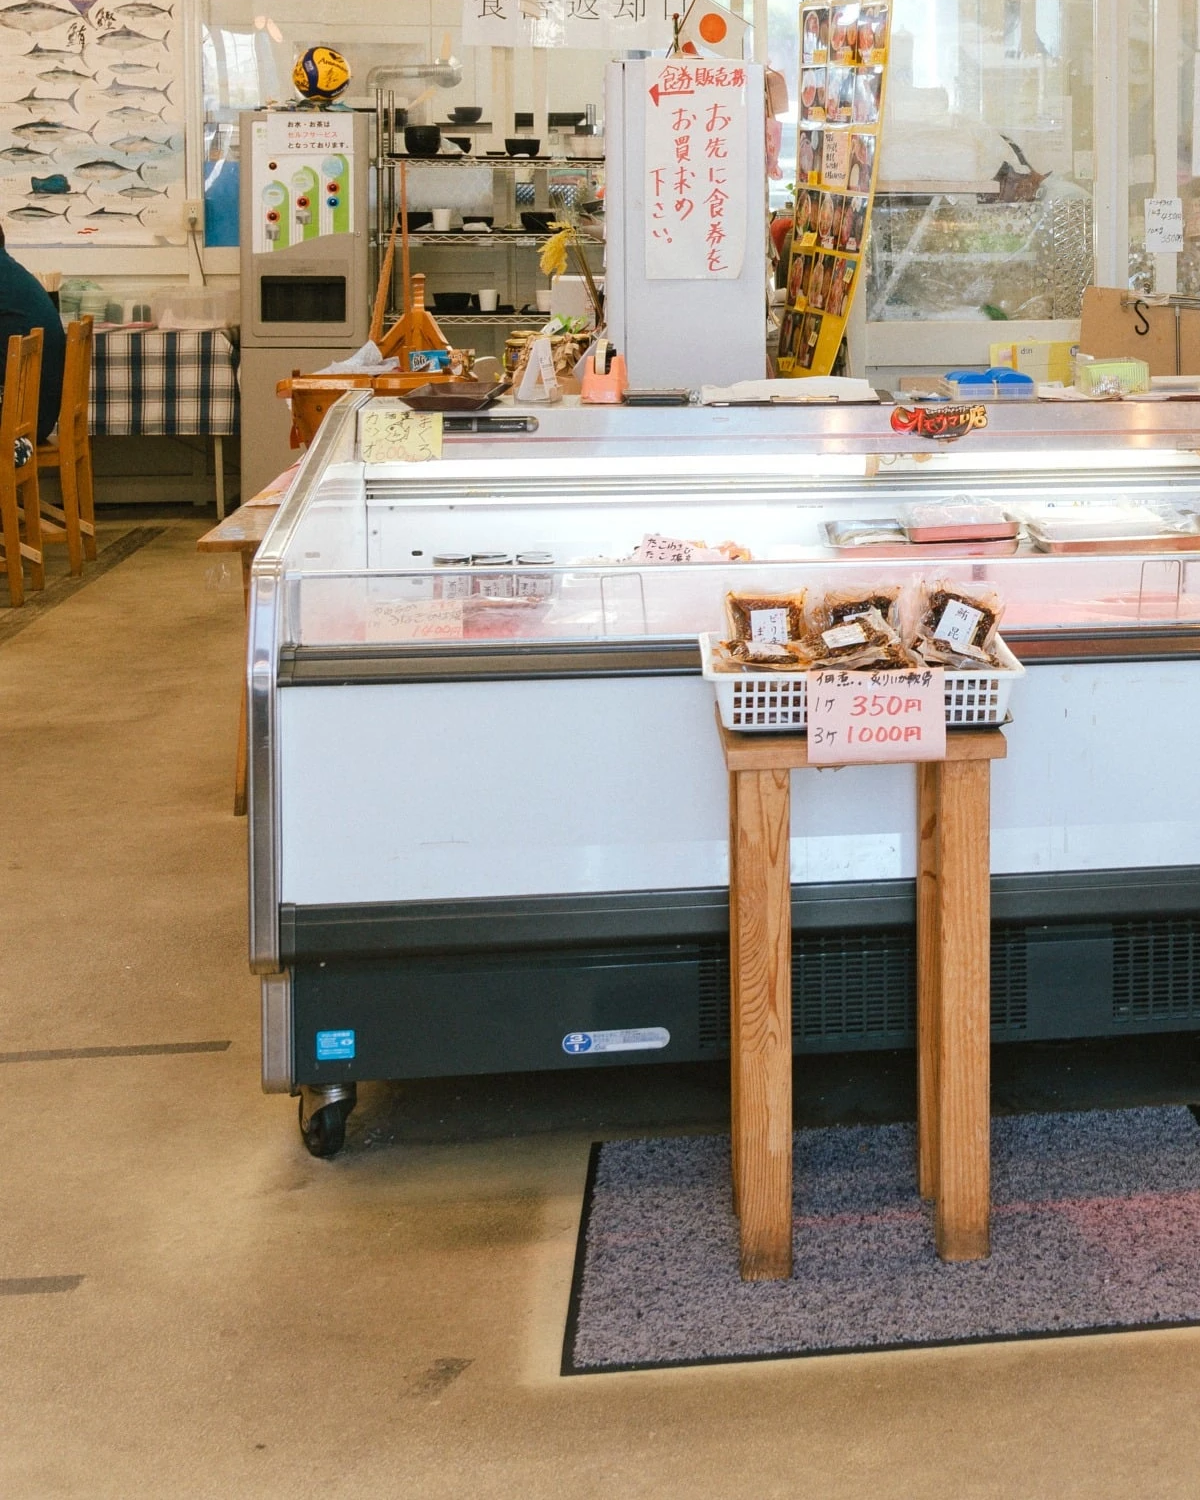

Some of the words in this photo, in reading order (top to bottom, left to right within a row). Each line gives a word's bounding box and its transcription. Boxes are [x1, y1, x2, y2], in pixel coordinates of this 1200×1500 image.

[288, 131, 338, 139] セルフサービス
[672, 108, 696, 221] お買求め
[703, 103, 731, 272] お先に食券を
[850, 694, 922, 717] 350円
[848, 726, 922, 744] 1000円
